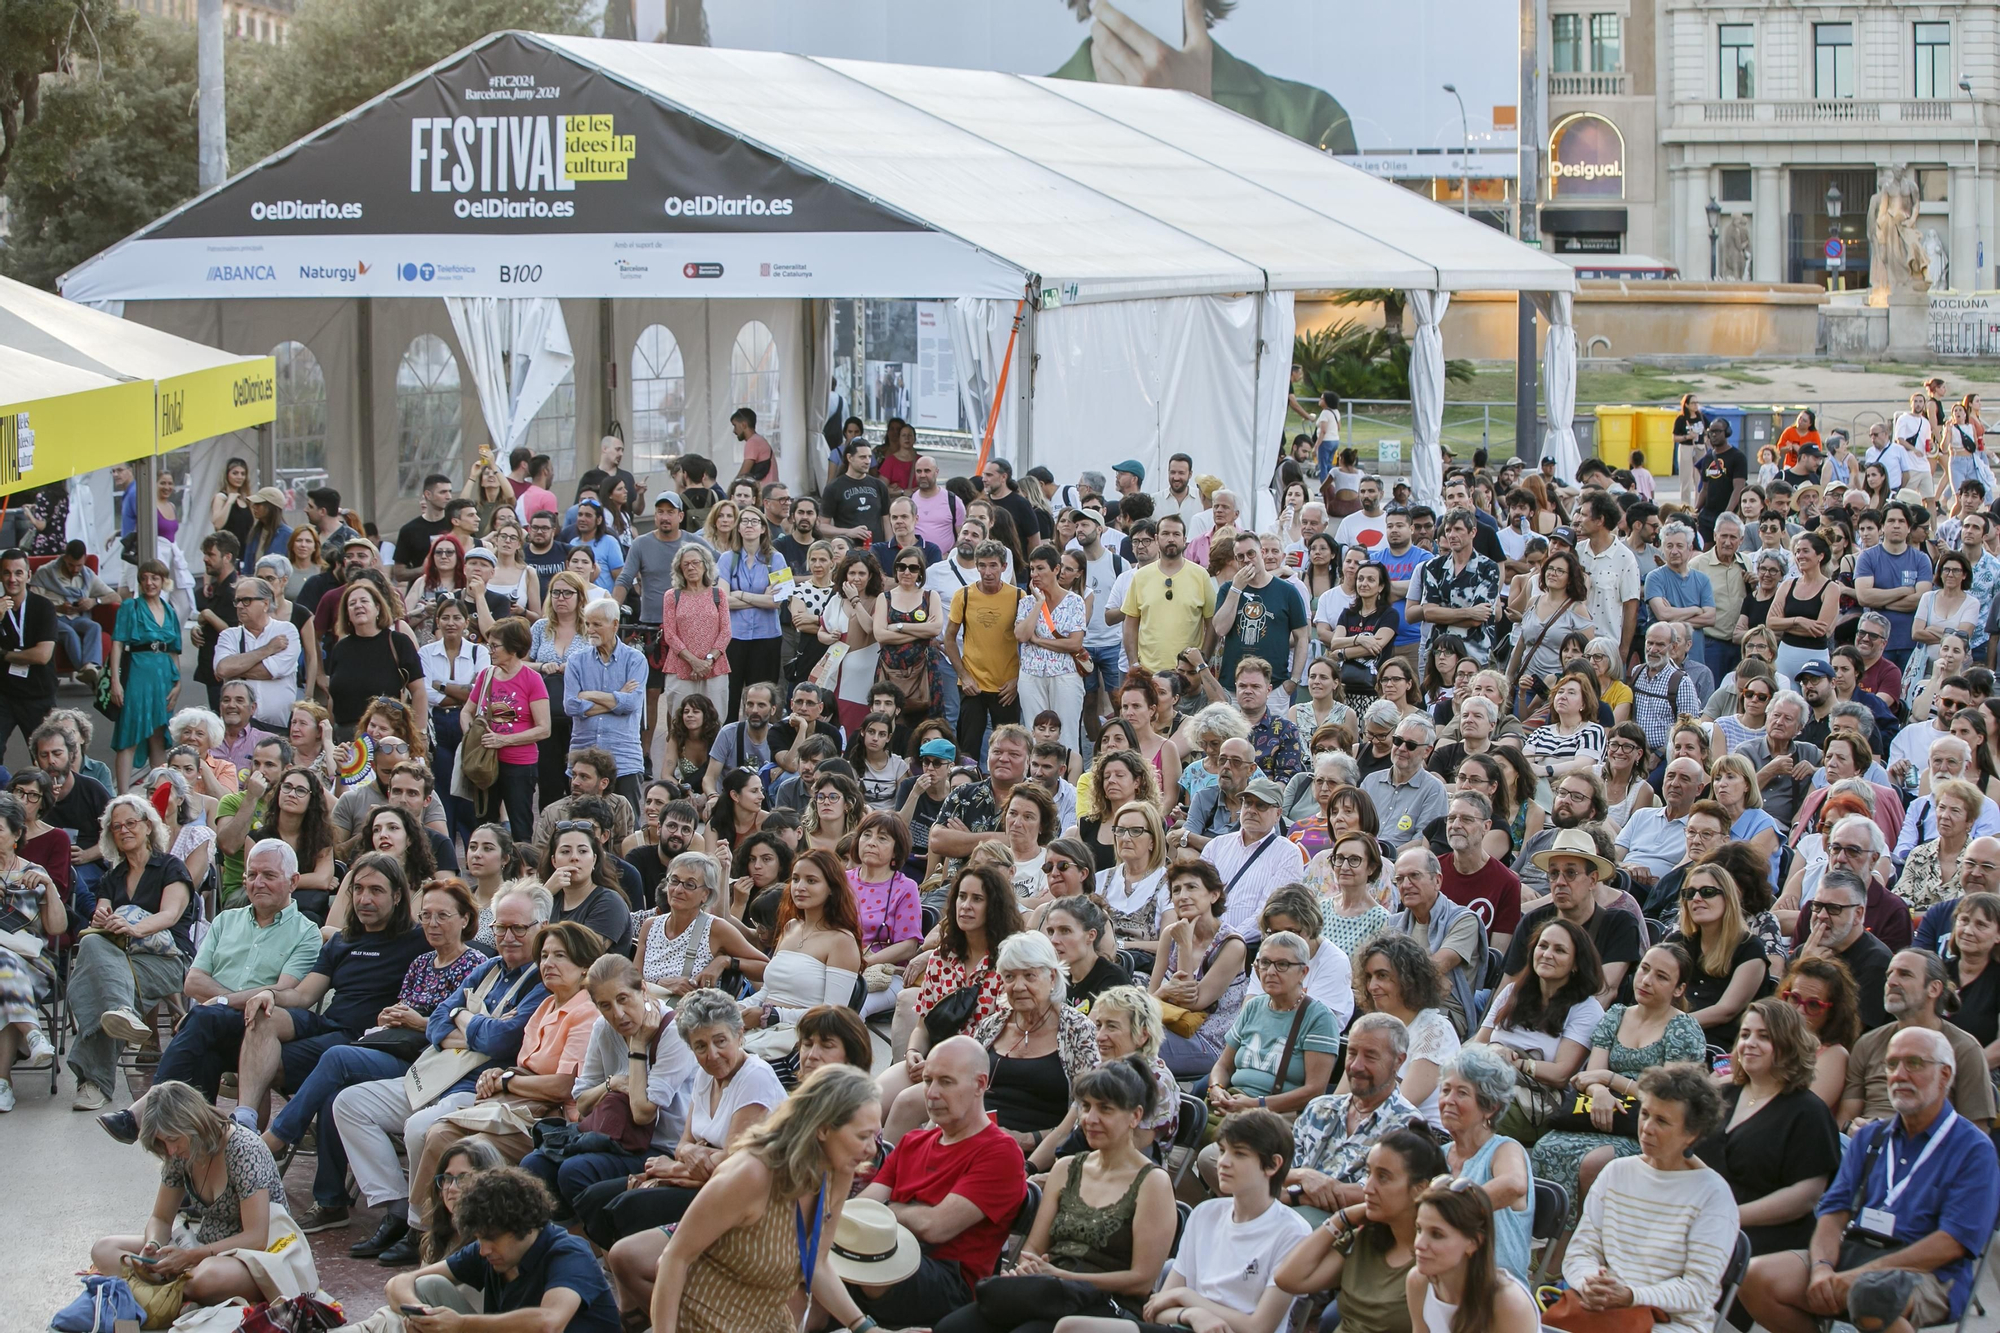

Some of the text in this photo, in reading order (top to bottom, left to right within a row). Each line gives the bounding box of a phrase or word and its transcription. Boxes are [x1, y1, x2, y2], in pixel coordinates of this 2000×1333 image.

[489, 75, 535, 87] #FIC2024
[511, 88, 535, 101] Juny
[536, 87, 561, 99] 2024
[565, 116, 612, 132] de les
[565, 137, 634, 153] idees i la
[411, 115, 576, 192] FESTIVAL
[565, 158, 626, 174] cultura
[300, 265, 357, 282] Naturgy
[782, 270, 813, 278] Catalunya
[162, 389, 184, 437] Hola!
[1247, 605, 1260, 615] 74
